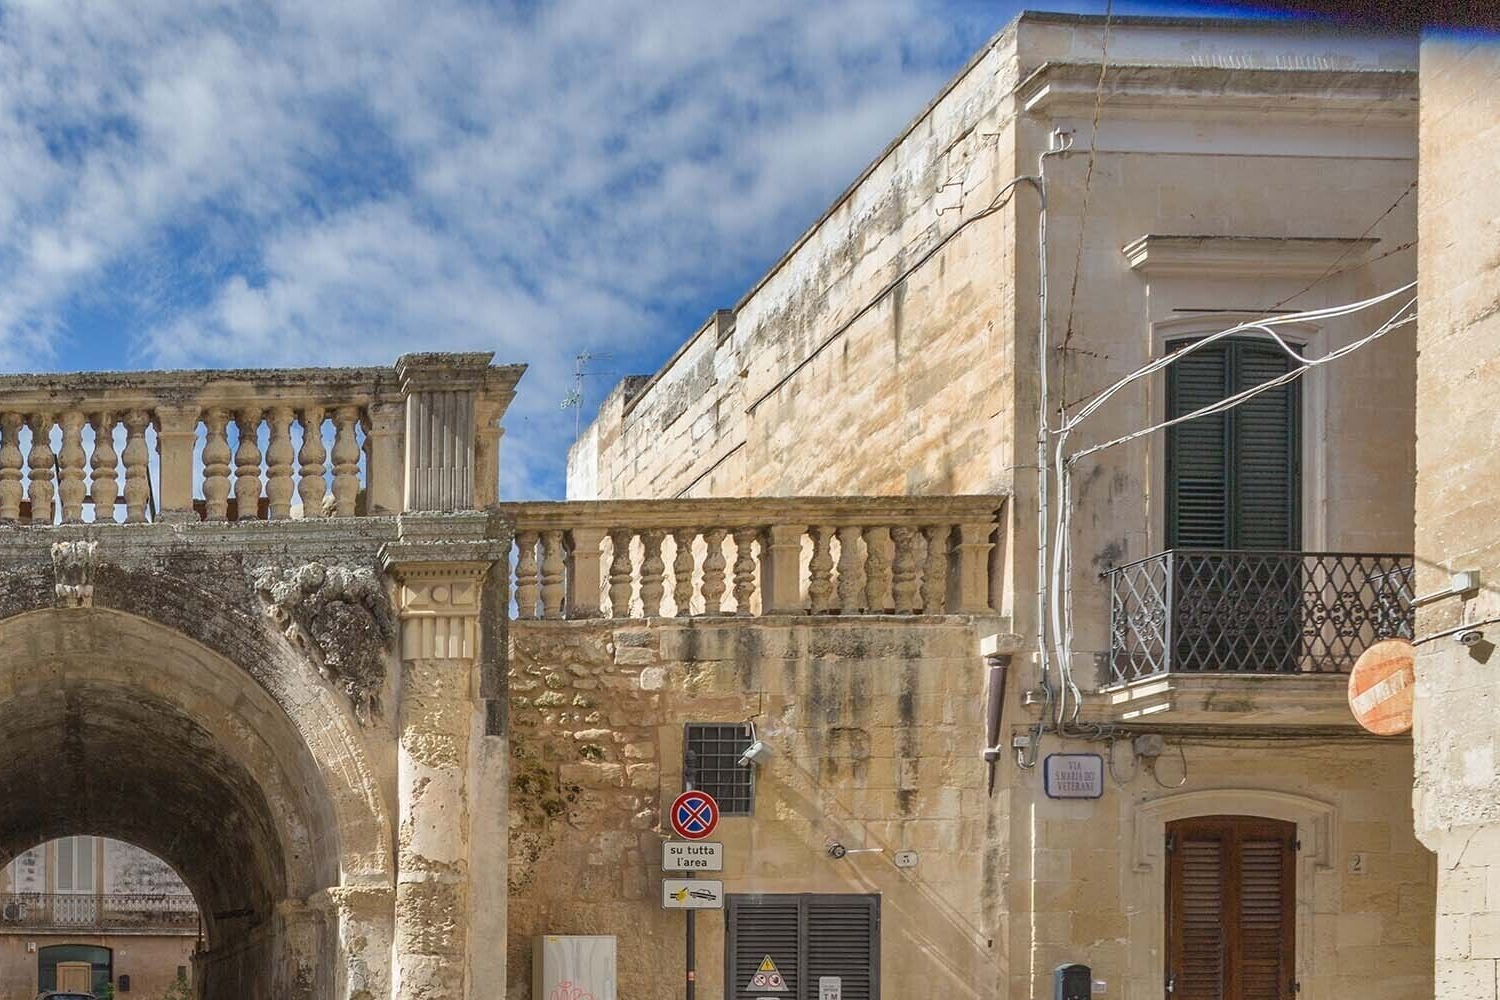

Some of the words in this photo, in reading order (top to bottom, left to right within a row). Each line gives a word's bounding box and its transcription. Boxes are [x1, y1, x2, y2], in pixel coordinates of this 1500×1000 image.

[1068, 761, 1082, 770] VIA
[670, 847, 683, 855] su
[687, 845, 715, 855] tutta
[677, 857, 707, 867] l'area
